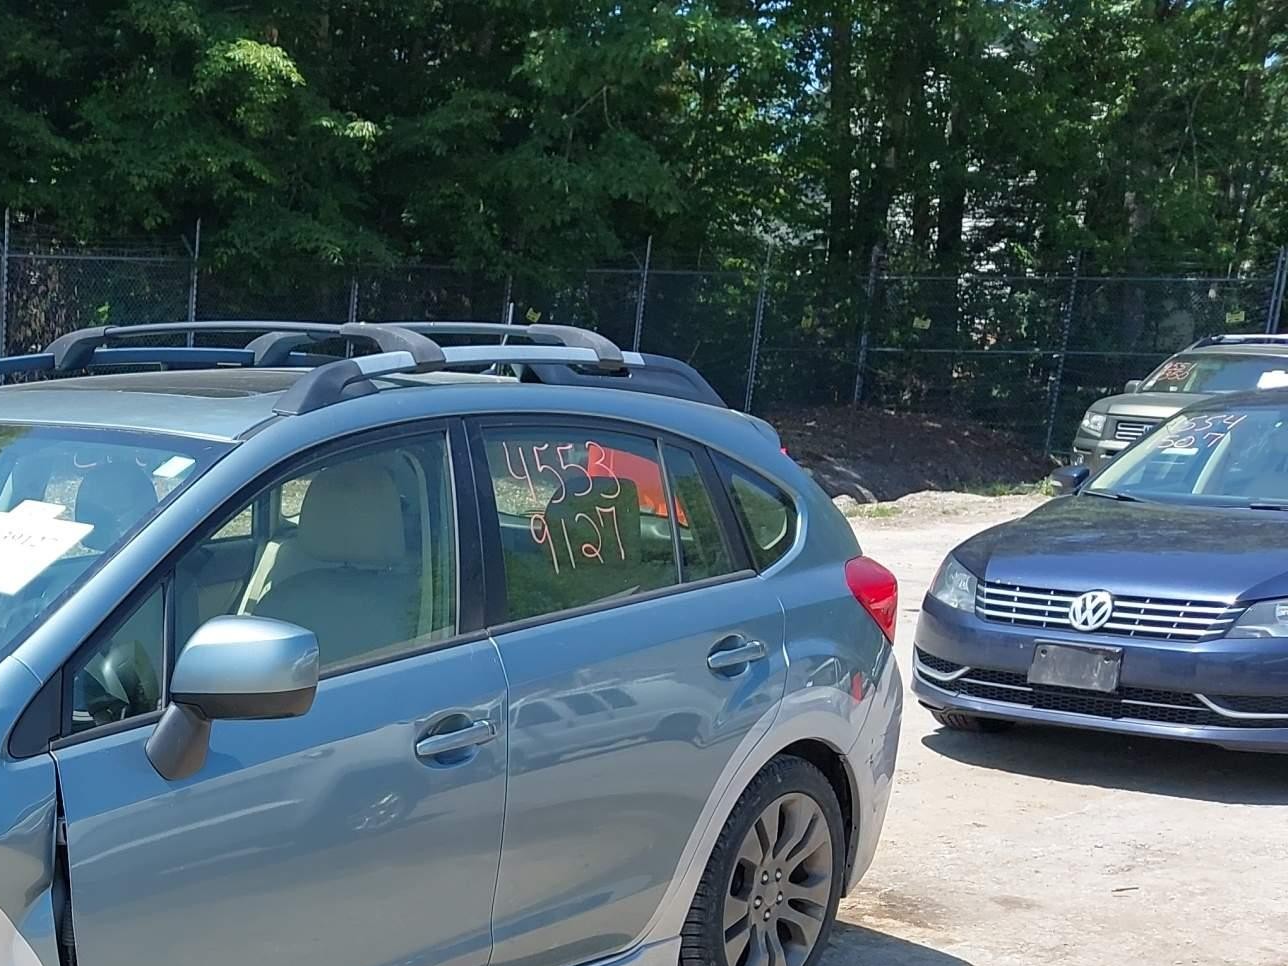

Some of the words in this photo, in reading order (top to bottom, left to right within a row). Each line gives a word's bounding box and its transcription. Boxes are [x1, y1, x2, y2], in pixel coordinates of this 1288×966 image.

[502, 441, 621, 504] 4553
[530, 505, 626, 575] 9127
[1069, 589, 1113, 632] VW
